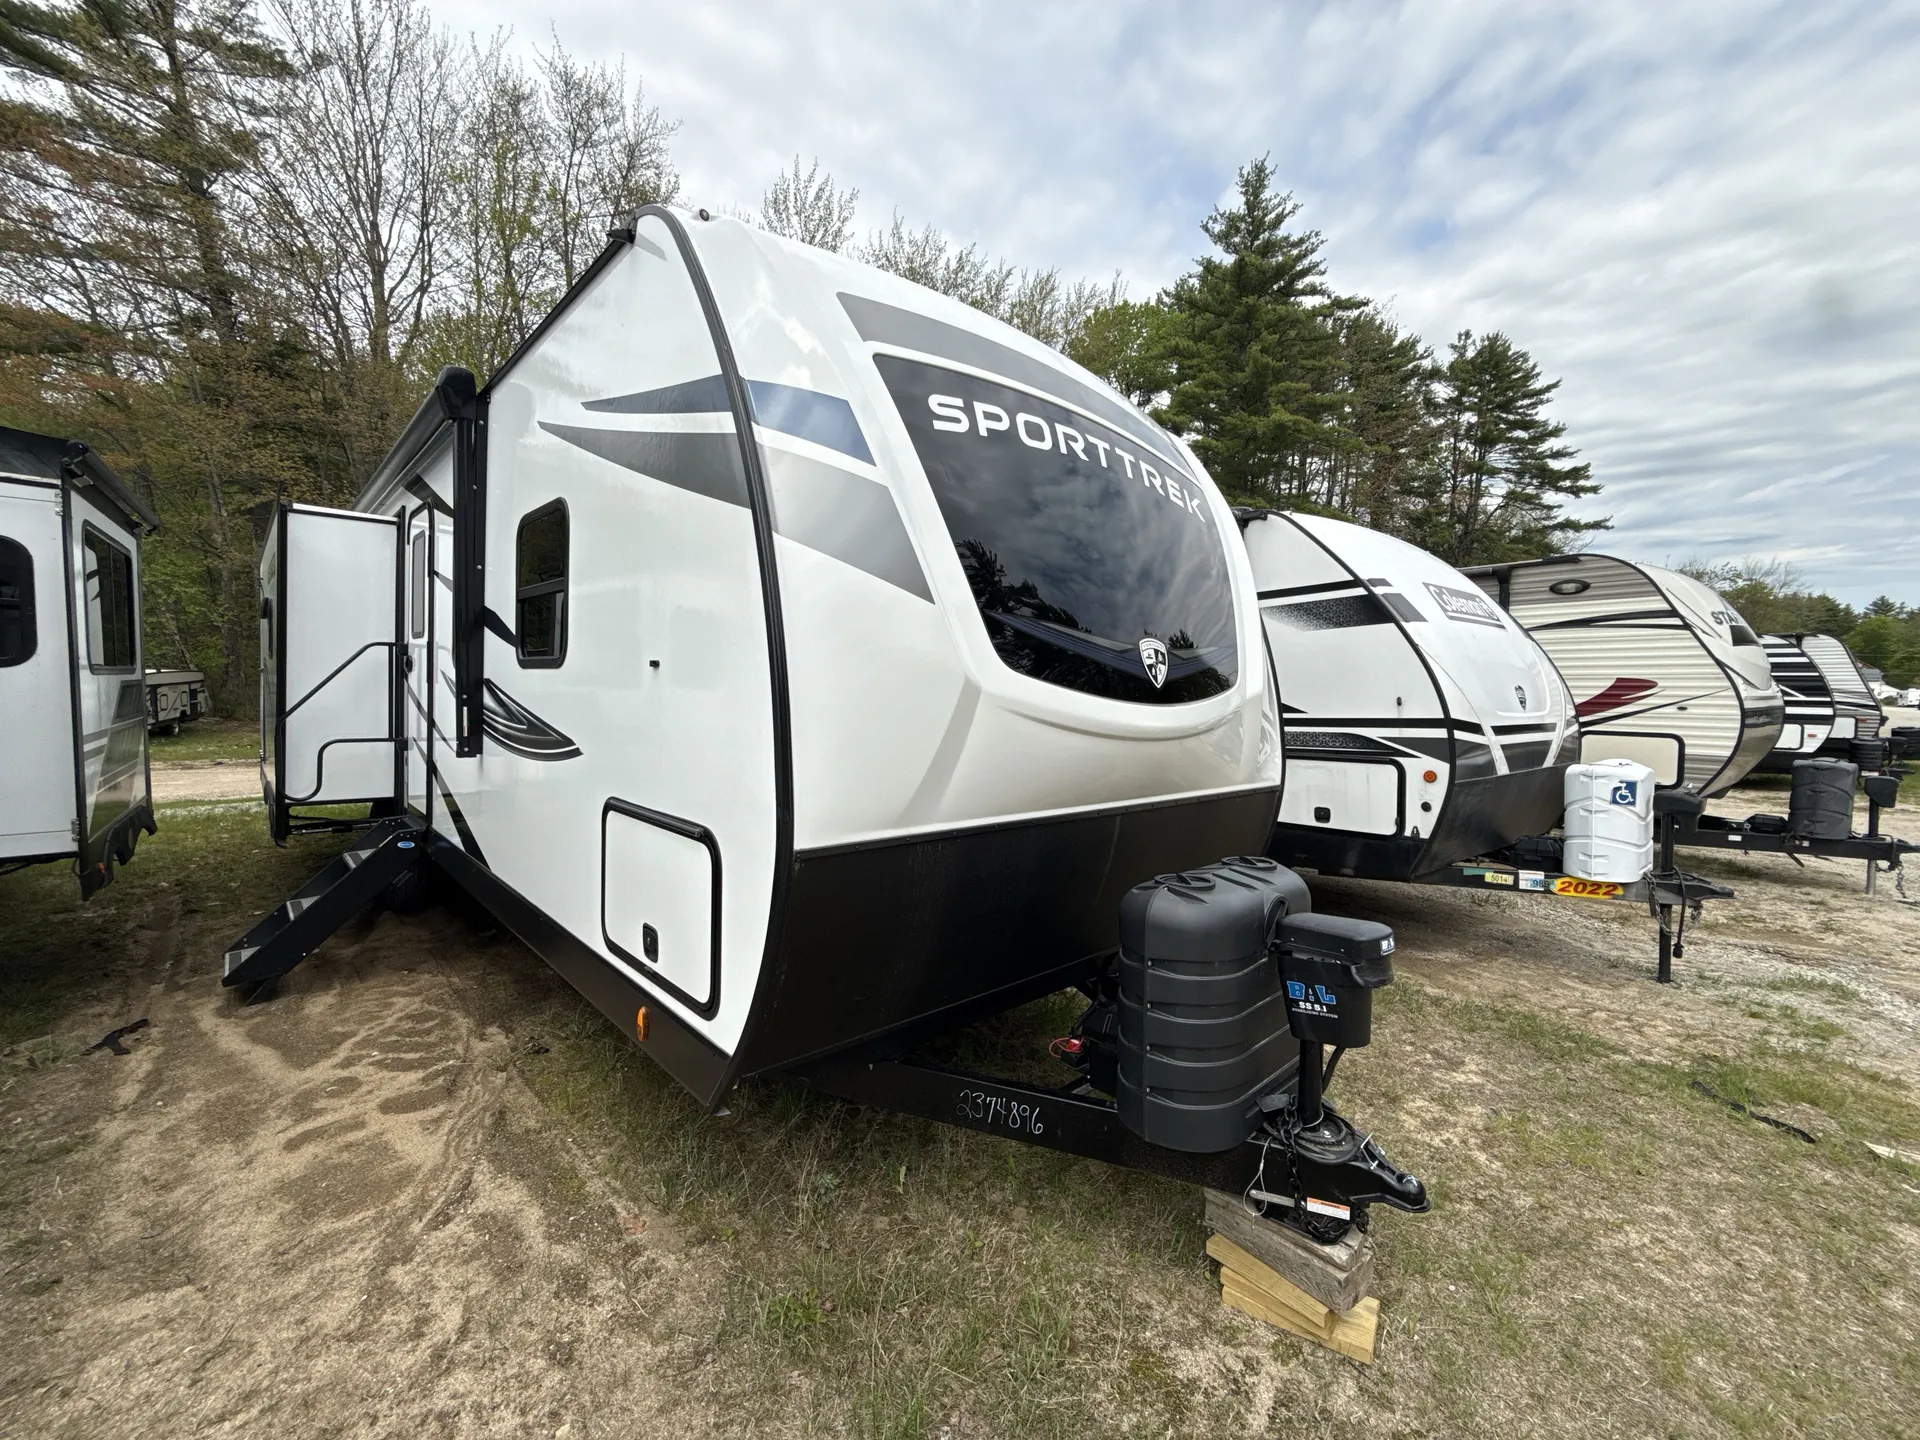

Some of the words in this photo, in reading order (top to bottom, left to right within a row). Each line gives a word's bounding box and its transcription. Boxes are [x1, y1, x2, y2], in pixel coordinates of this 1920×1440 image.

[927, 394, 1206, 523] SPORTTREK
[1429, 585, 1497, 619] Coleman
[1557, 880, 1619, 896] 2022
[1298, 1001, 1312, 1010] SS
[1313, 1003, 1327, 1013] 5.1
[956, 1089, 1044, 1135] 2374896
